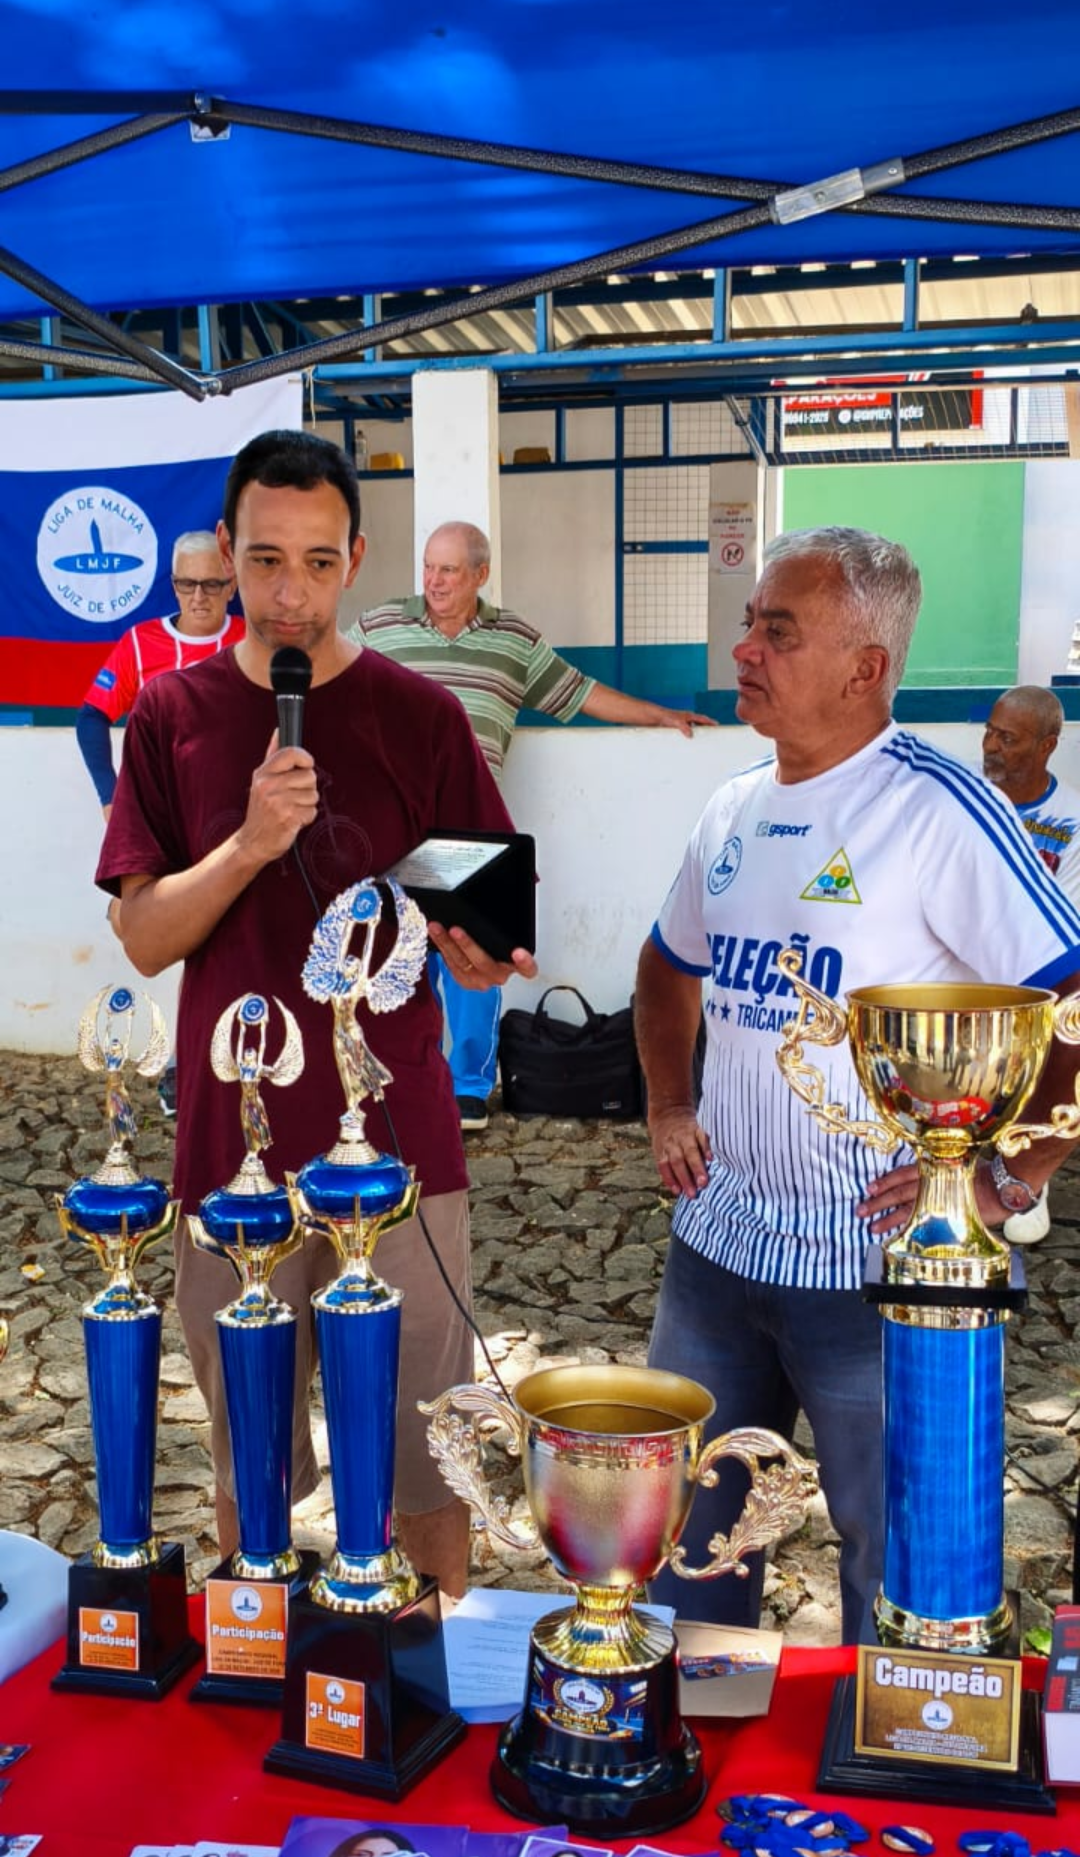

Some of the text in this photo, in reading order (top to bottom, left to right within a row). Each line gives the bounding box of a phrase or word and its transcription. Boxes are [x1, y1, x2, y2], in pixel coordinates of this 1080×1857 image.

[48, 497, 144, 534] LIGA DE MALHA
[57, 583, 141, 613] JUIZ DE FORA
[706, 933, 843, 1005] ELEÇÃO
[81, 1631, 136, 1648] Participação
[212, 1624, 285, 1642] Participação
[875, 1656, 1003, 1698] Campeão
[327, 1704, 361, 1729] Lugar
